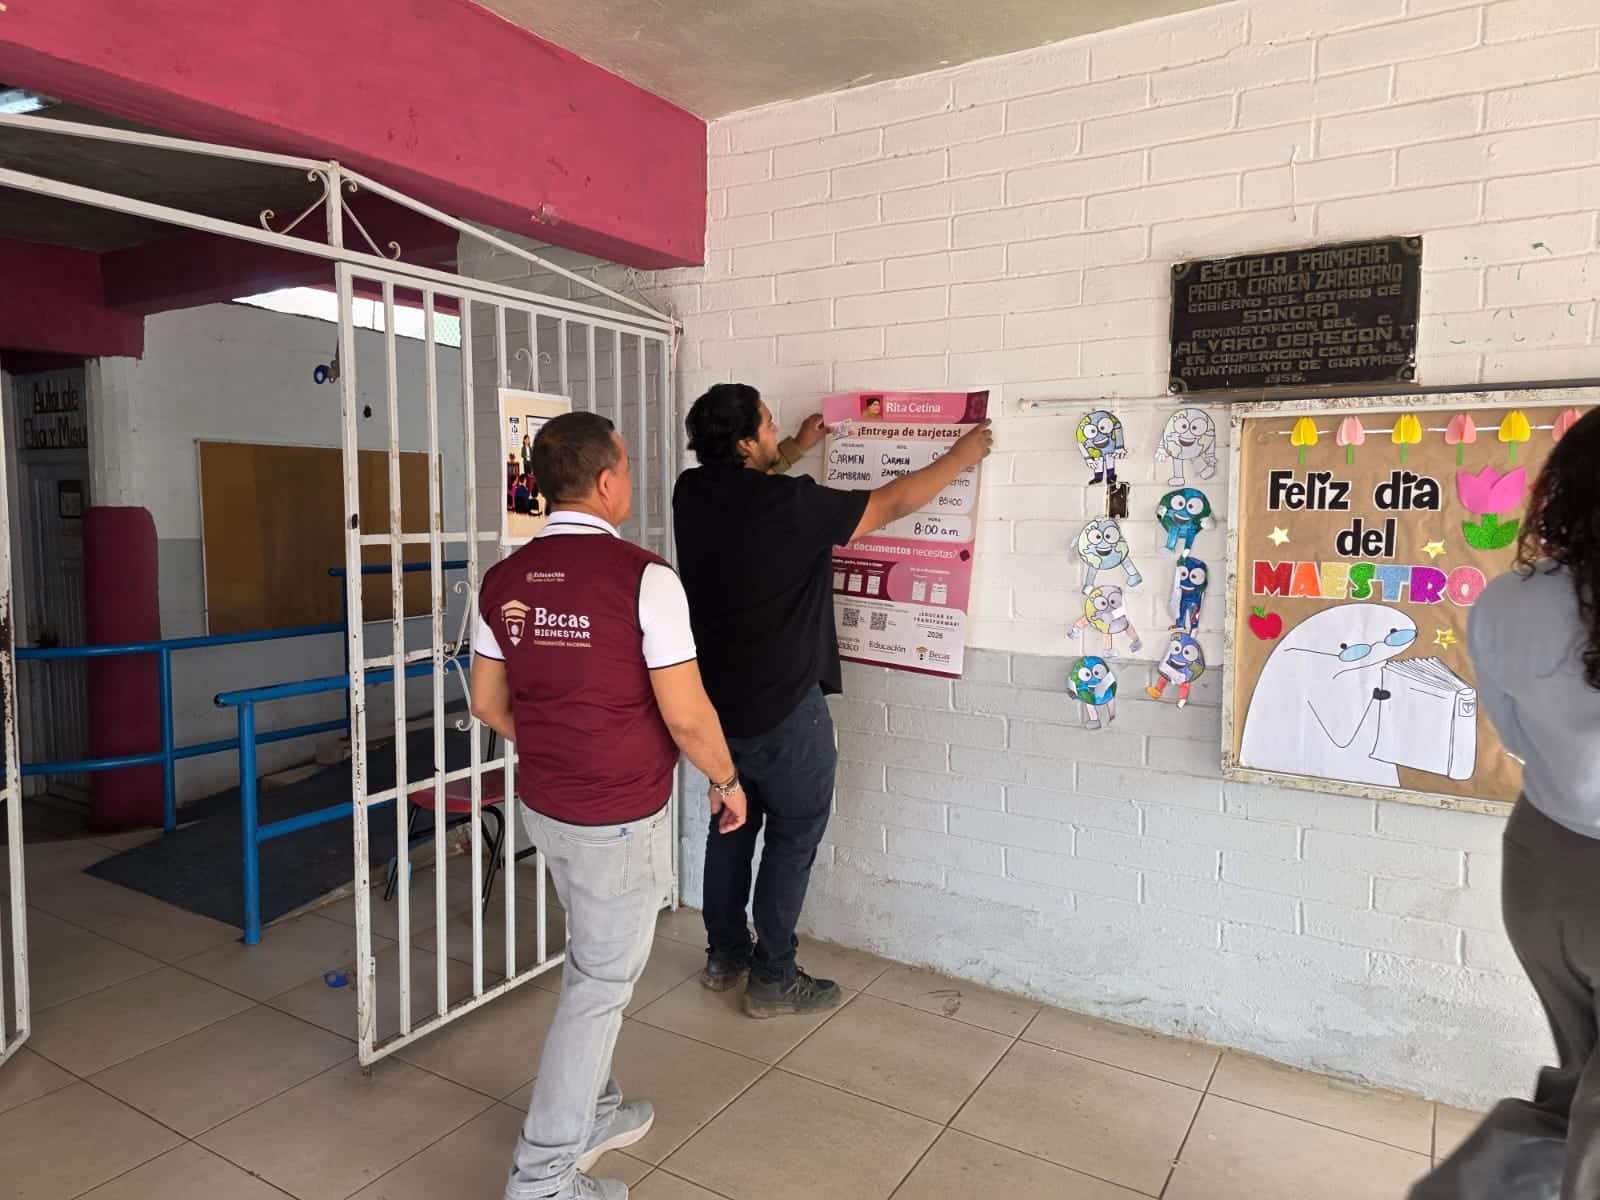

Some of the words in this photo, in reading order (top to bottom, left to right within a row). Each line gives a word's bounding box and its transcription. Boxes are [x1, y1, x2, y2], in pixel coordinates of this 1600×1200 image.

[1200, 256, 1287, 282] ESCUELA
[1298, 244, 1390, 271] PRIMARIA
[1188, 281, 1241, 301] PROFA.
[1247, 273, 1311, 296] CARMEN
[1316, 263, 1403, 290] ZAMBRANO
[1188, 297, 1262, 313] GOBIERNO
[1304, 287, 1371, 303] ESTADO
[1377, 284, 1401, 297] DE
[1242, 302, 1339, 324] SONORA
[1192, 319, 1318, 339] ADMINISTRACION
[1323, 314, 1358, 328] DEL
[1178, 335, 1268, 355] ALVARO
[1276, 325, 1392, 349] OBREGON
[1185, 354, 1206, 367] EN
[1210, 347, 1314, 365] COOPERACION
[1318, 345, 1353, 358] CON
[1357, 343, 1378, 355] EL
[1181, 359, 1293, 377] AYUNTAMIENTO
[1298, 358, 1321, 371] DE
[62, 376, 79, 410] de
[885, 402, 908, 414] Rita
[908, 402, 941, 414] Cetina
[857, 426, 901, 439] ¡Entrega
[902, 427, 915, 438] de
[917, 427, 961, 439] tarjetas!
[829, 449, 865, 465] CARMEN
[881, 453, 911, 466] CARMEN
[828, 468, 872, 481] ZAMBRANO
[1267, 469, 1352, 512] Feliz
[914, 522, 938, 535] 8:00
[1335, 517, 1398, 558] del
[854, 541, 912, 556] documentos
[912, 544, 957, 559] necesitas?
[1252, 560, 1487, 607] MAESTRO
[534, 607, 591, 629] Becas
[534, 629, 591, 640] BIENESTAR
